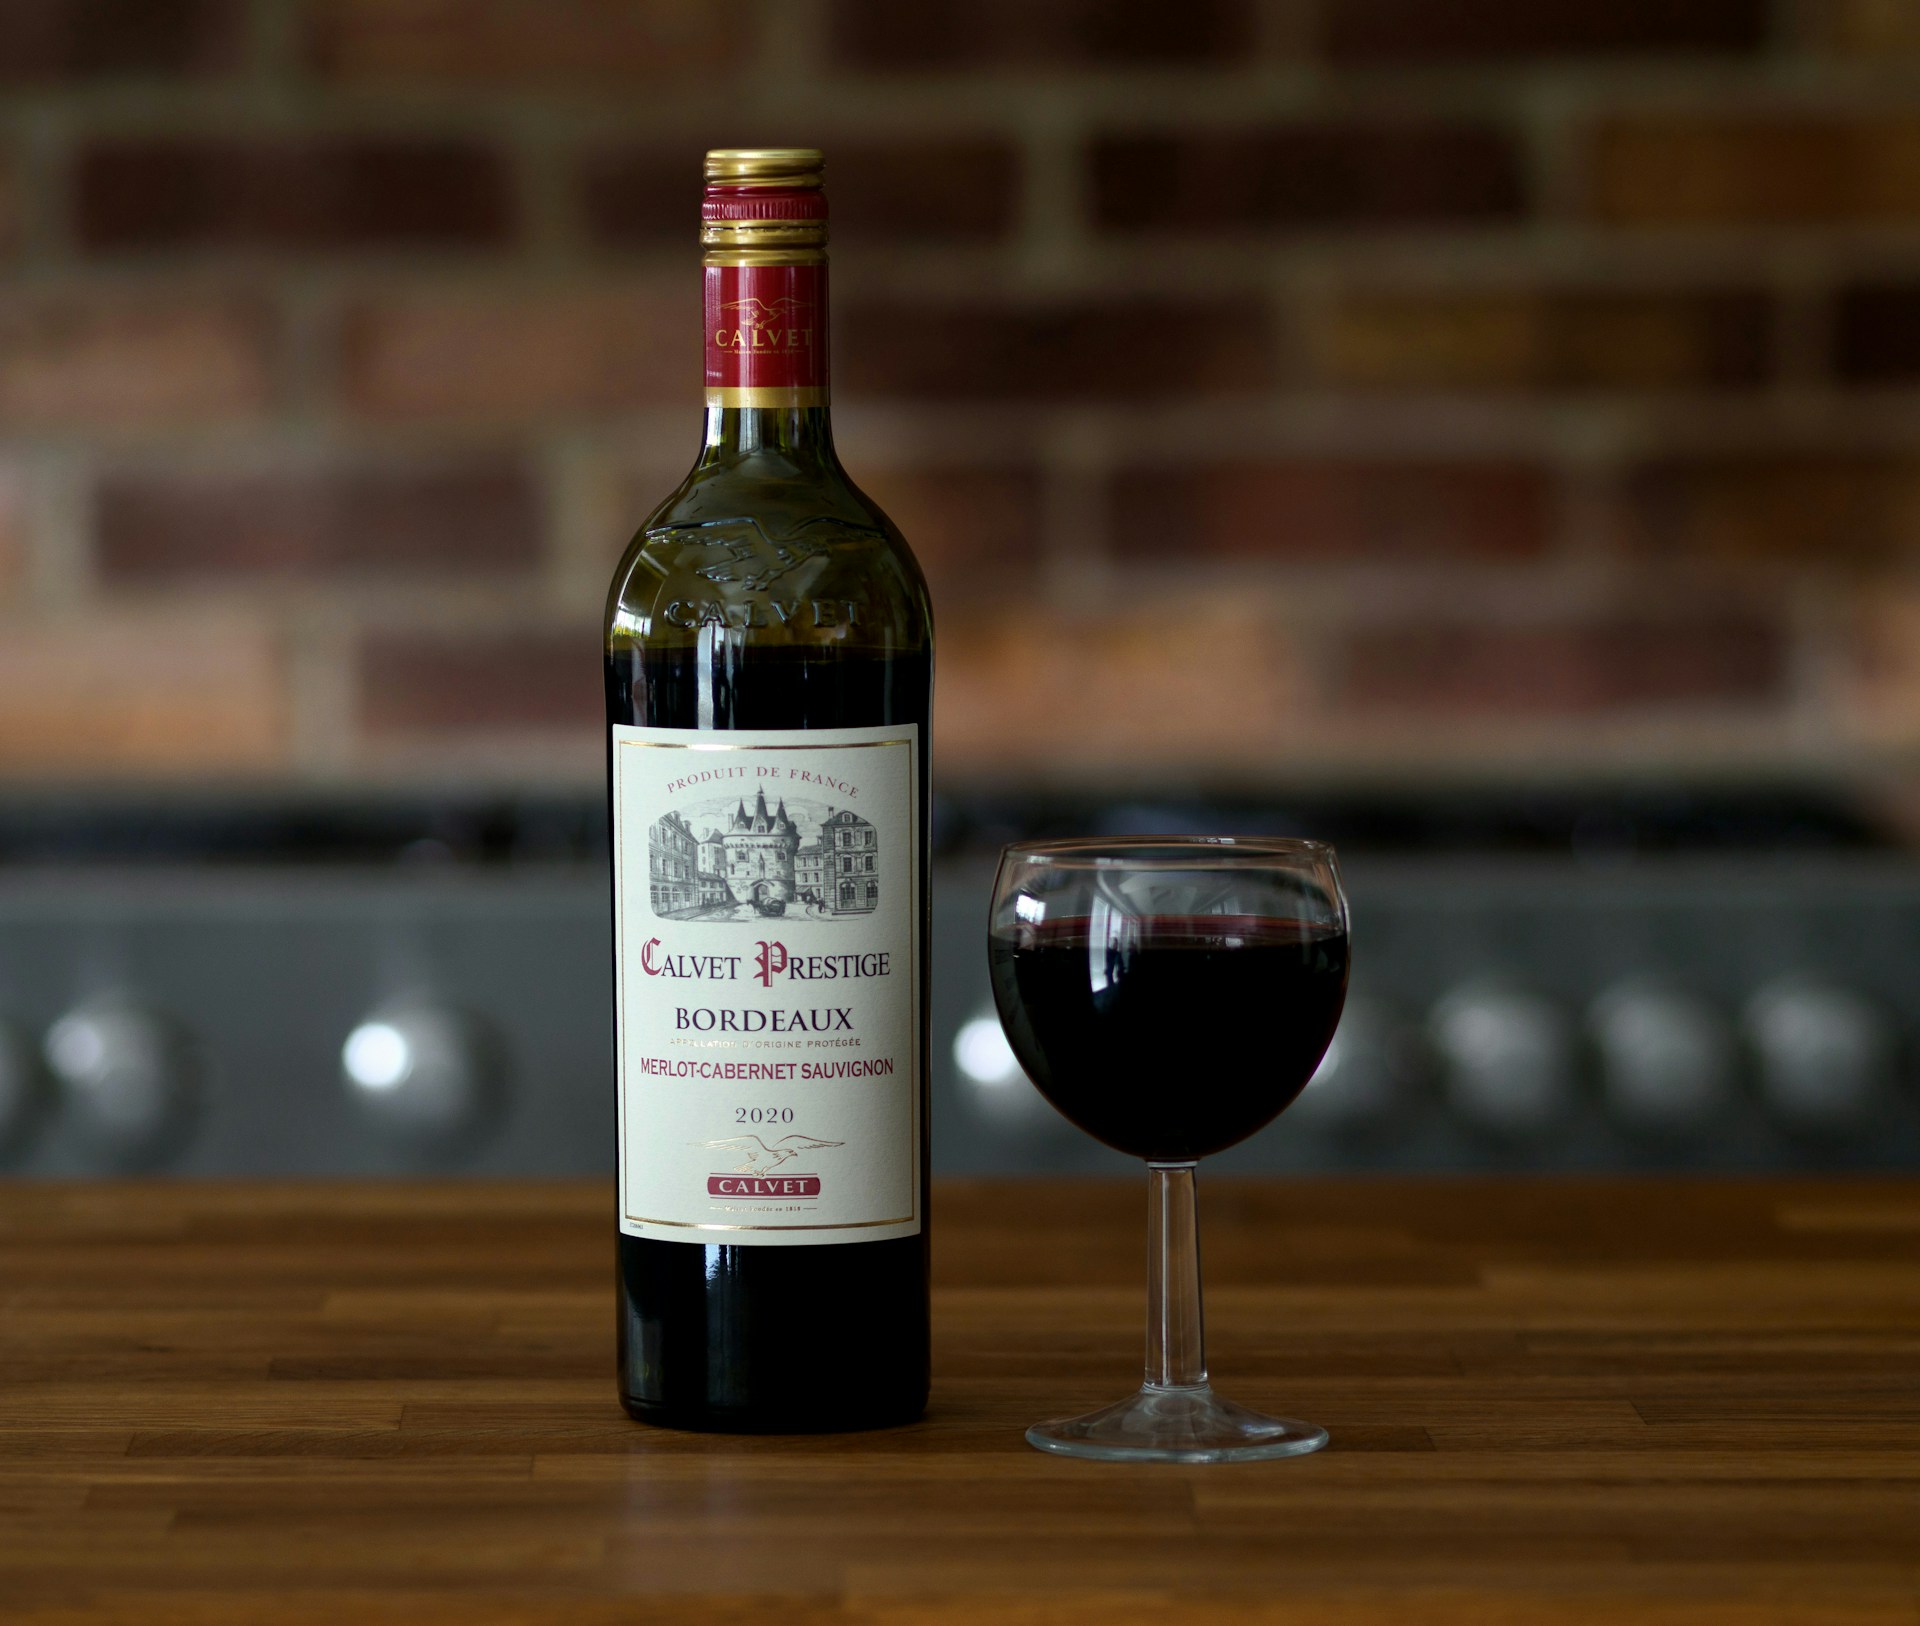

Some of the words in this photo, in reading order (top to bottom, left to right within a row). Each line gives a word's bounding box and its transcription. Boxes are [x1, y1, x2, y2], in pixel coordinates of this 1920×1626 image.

[715, 329, 813, 347] CALVET
[664, 599, 862, 628] CALVET
[667, 766, 748, 793] PRODUIT
[757, 766, 781, 778] DE
[789, 769, 860, 798] FRANCE
[675, 1007, 855, 1032] BORDEAUX
[669, 1037, 736, 1048] APPELLATION
[742, 1040, 802, 1049] D'ORIGINE
[807, 1037, 861, 1048] PROTÉGÉE
[641, 1057, 797, 1080] MERLOT-CABERNET
[801, 1057, 894, 1080] SAUVIGNON
[735, 1107, 795, 1124] 2020
[718, 1179, 809, 1194] CALVET
